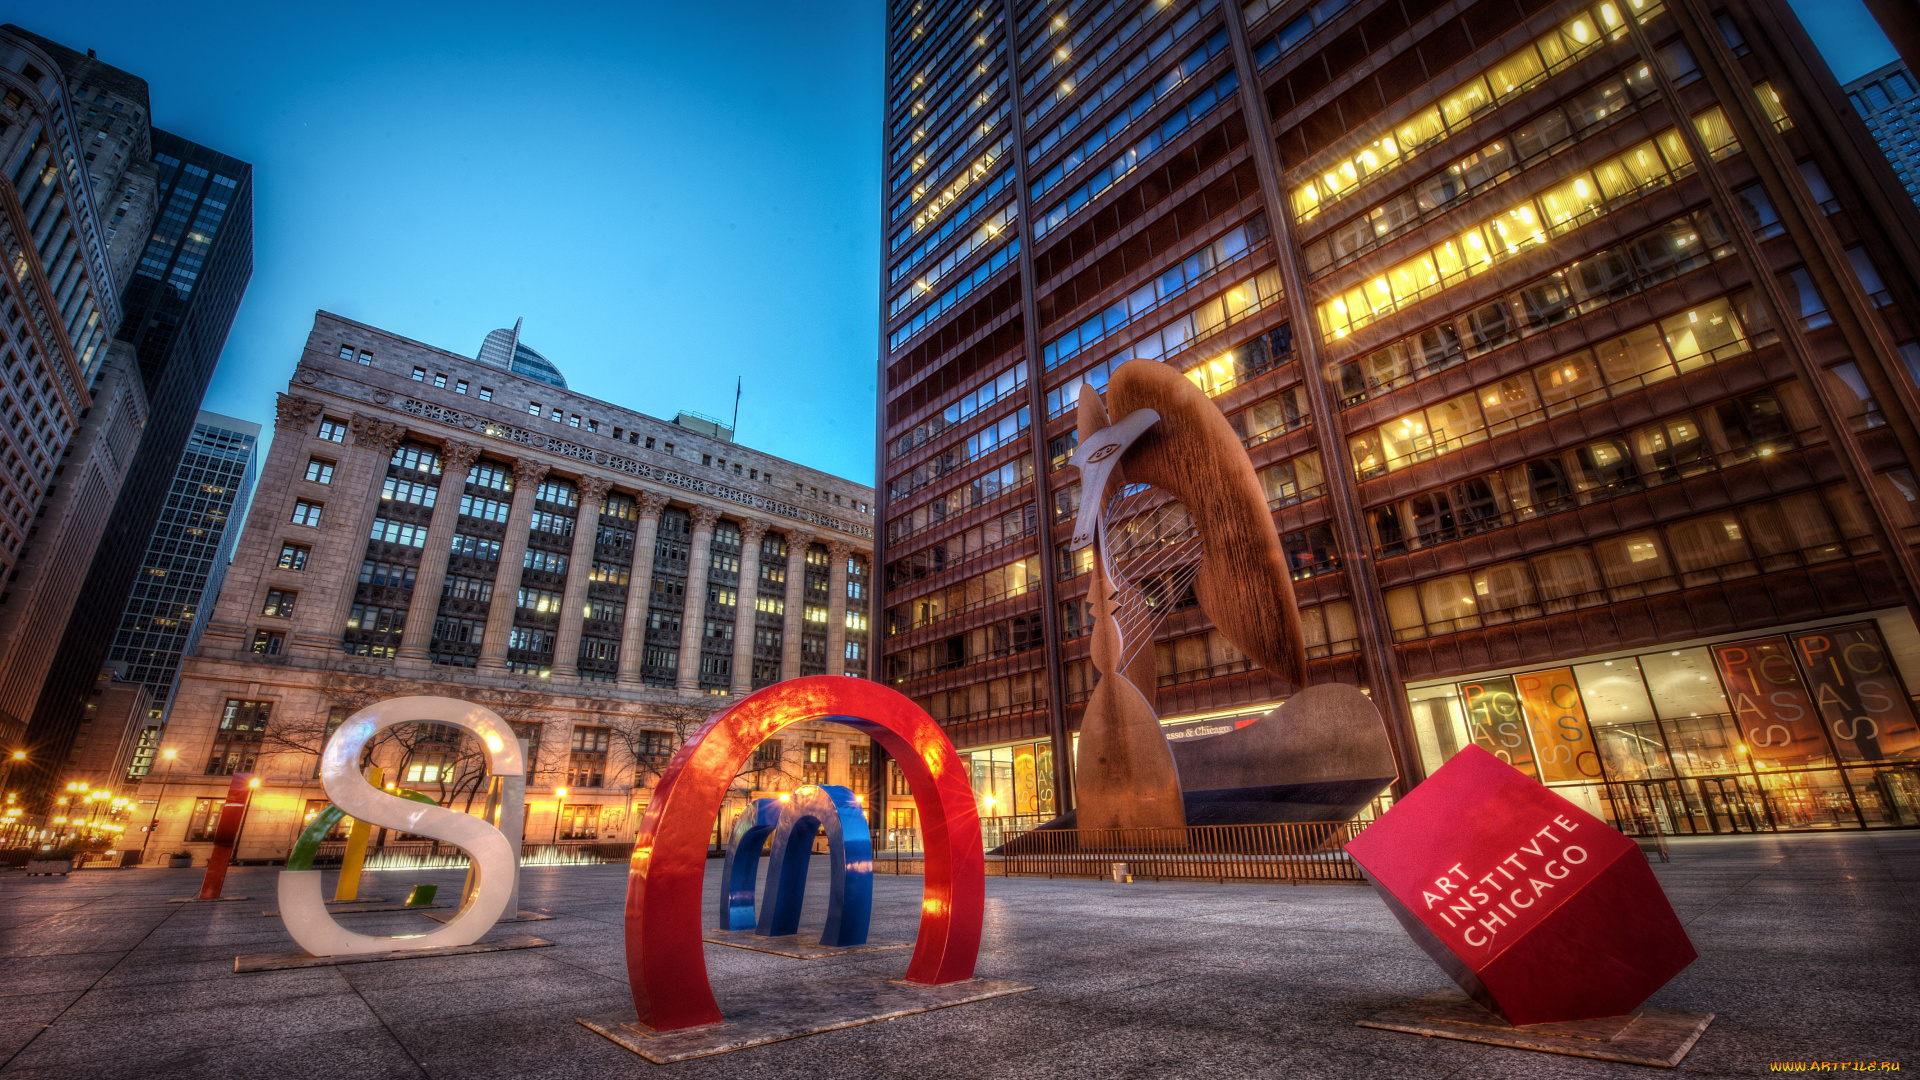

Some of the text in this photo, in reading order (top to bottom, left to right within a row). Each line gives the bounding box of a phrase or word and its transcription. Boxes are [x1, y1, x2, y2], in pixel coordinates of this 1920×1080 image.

[1185, 728, 1194, 738] &
[1703, 761, 1721, 770] 50
[1421, 862, 1472, 910] ART
[1439, 813, 1580, 928] INSTITVTE
[1463, 844, 1588, 947] CHICAGO
